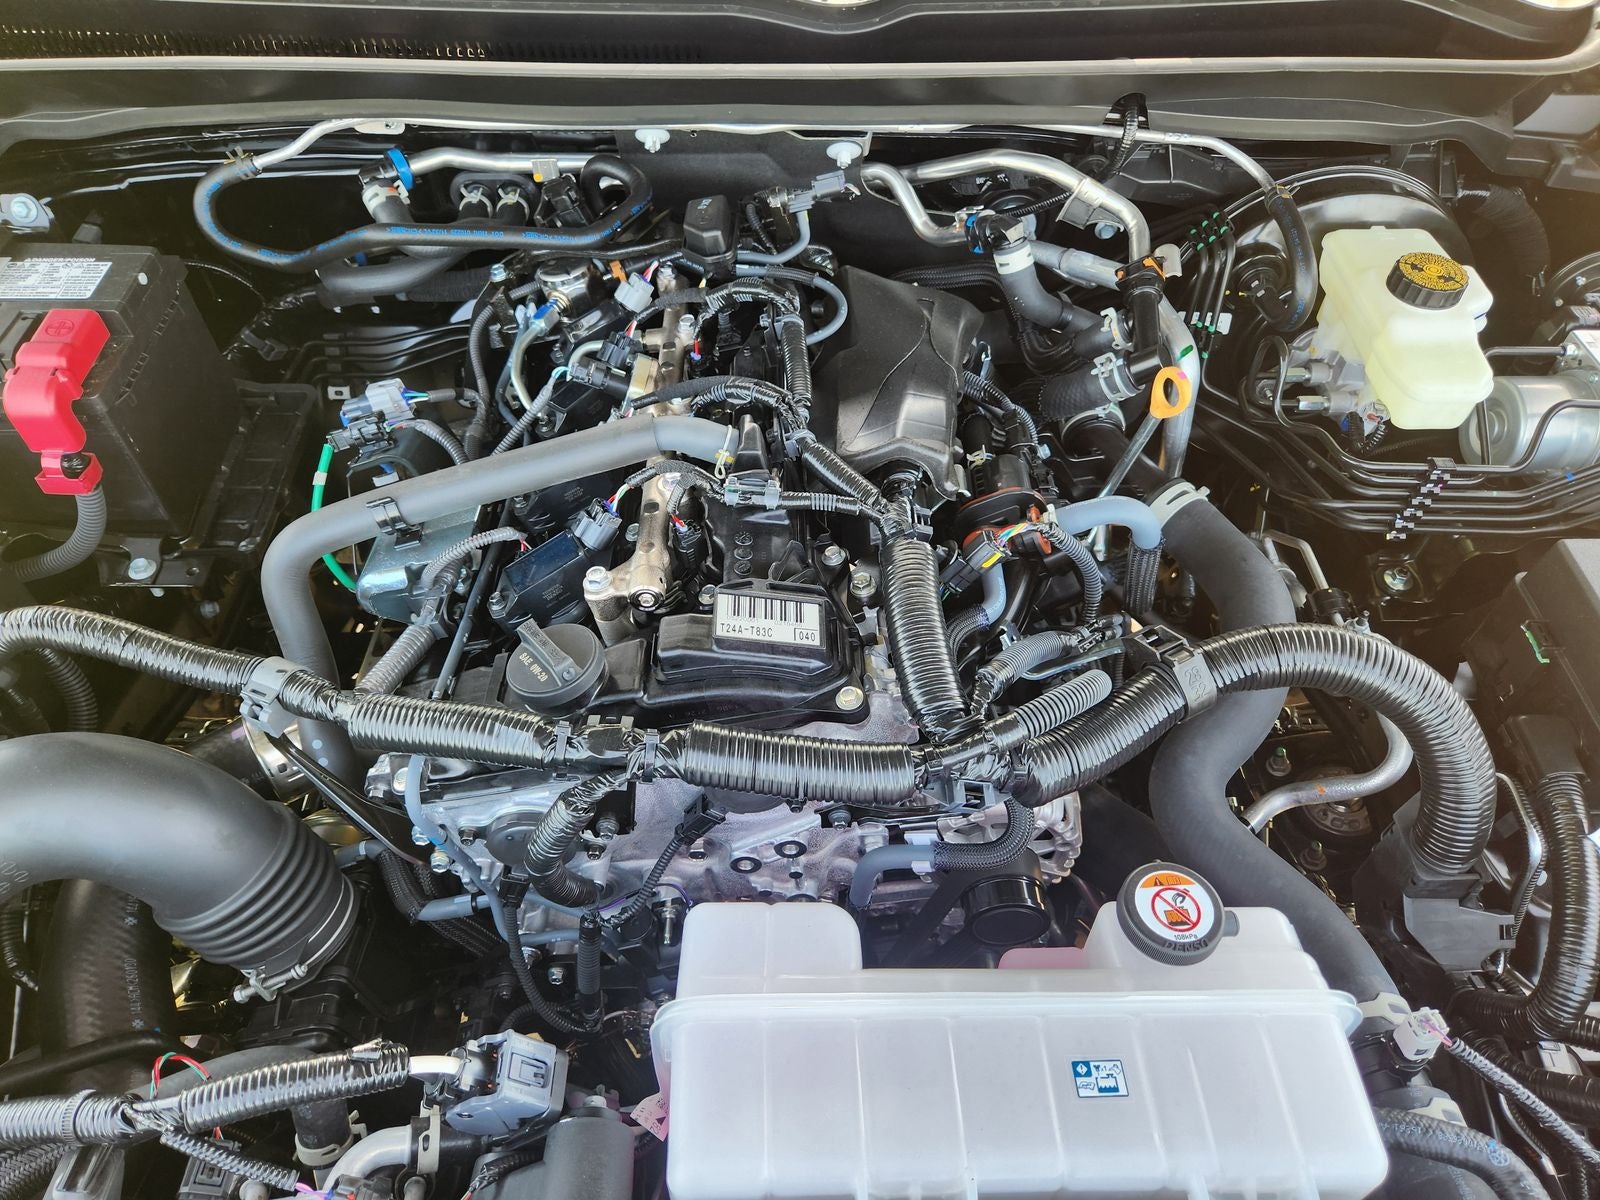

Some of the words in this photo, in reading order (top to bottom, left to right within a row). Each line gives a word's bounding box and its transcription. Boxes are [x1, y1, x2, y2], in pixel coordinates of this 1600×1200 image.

[720, 623, 773, 637] T24A-T83C
[799, 631, 816, 641] 040
[519, 652, 533, 666] SAE
[529, 664, 549, 682] 0W-20
[1174, 933, 1198, 941] 108kPa
[1163, 938, 1209, 952] DENSO
